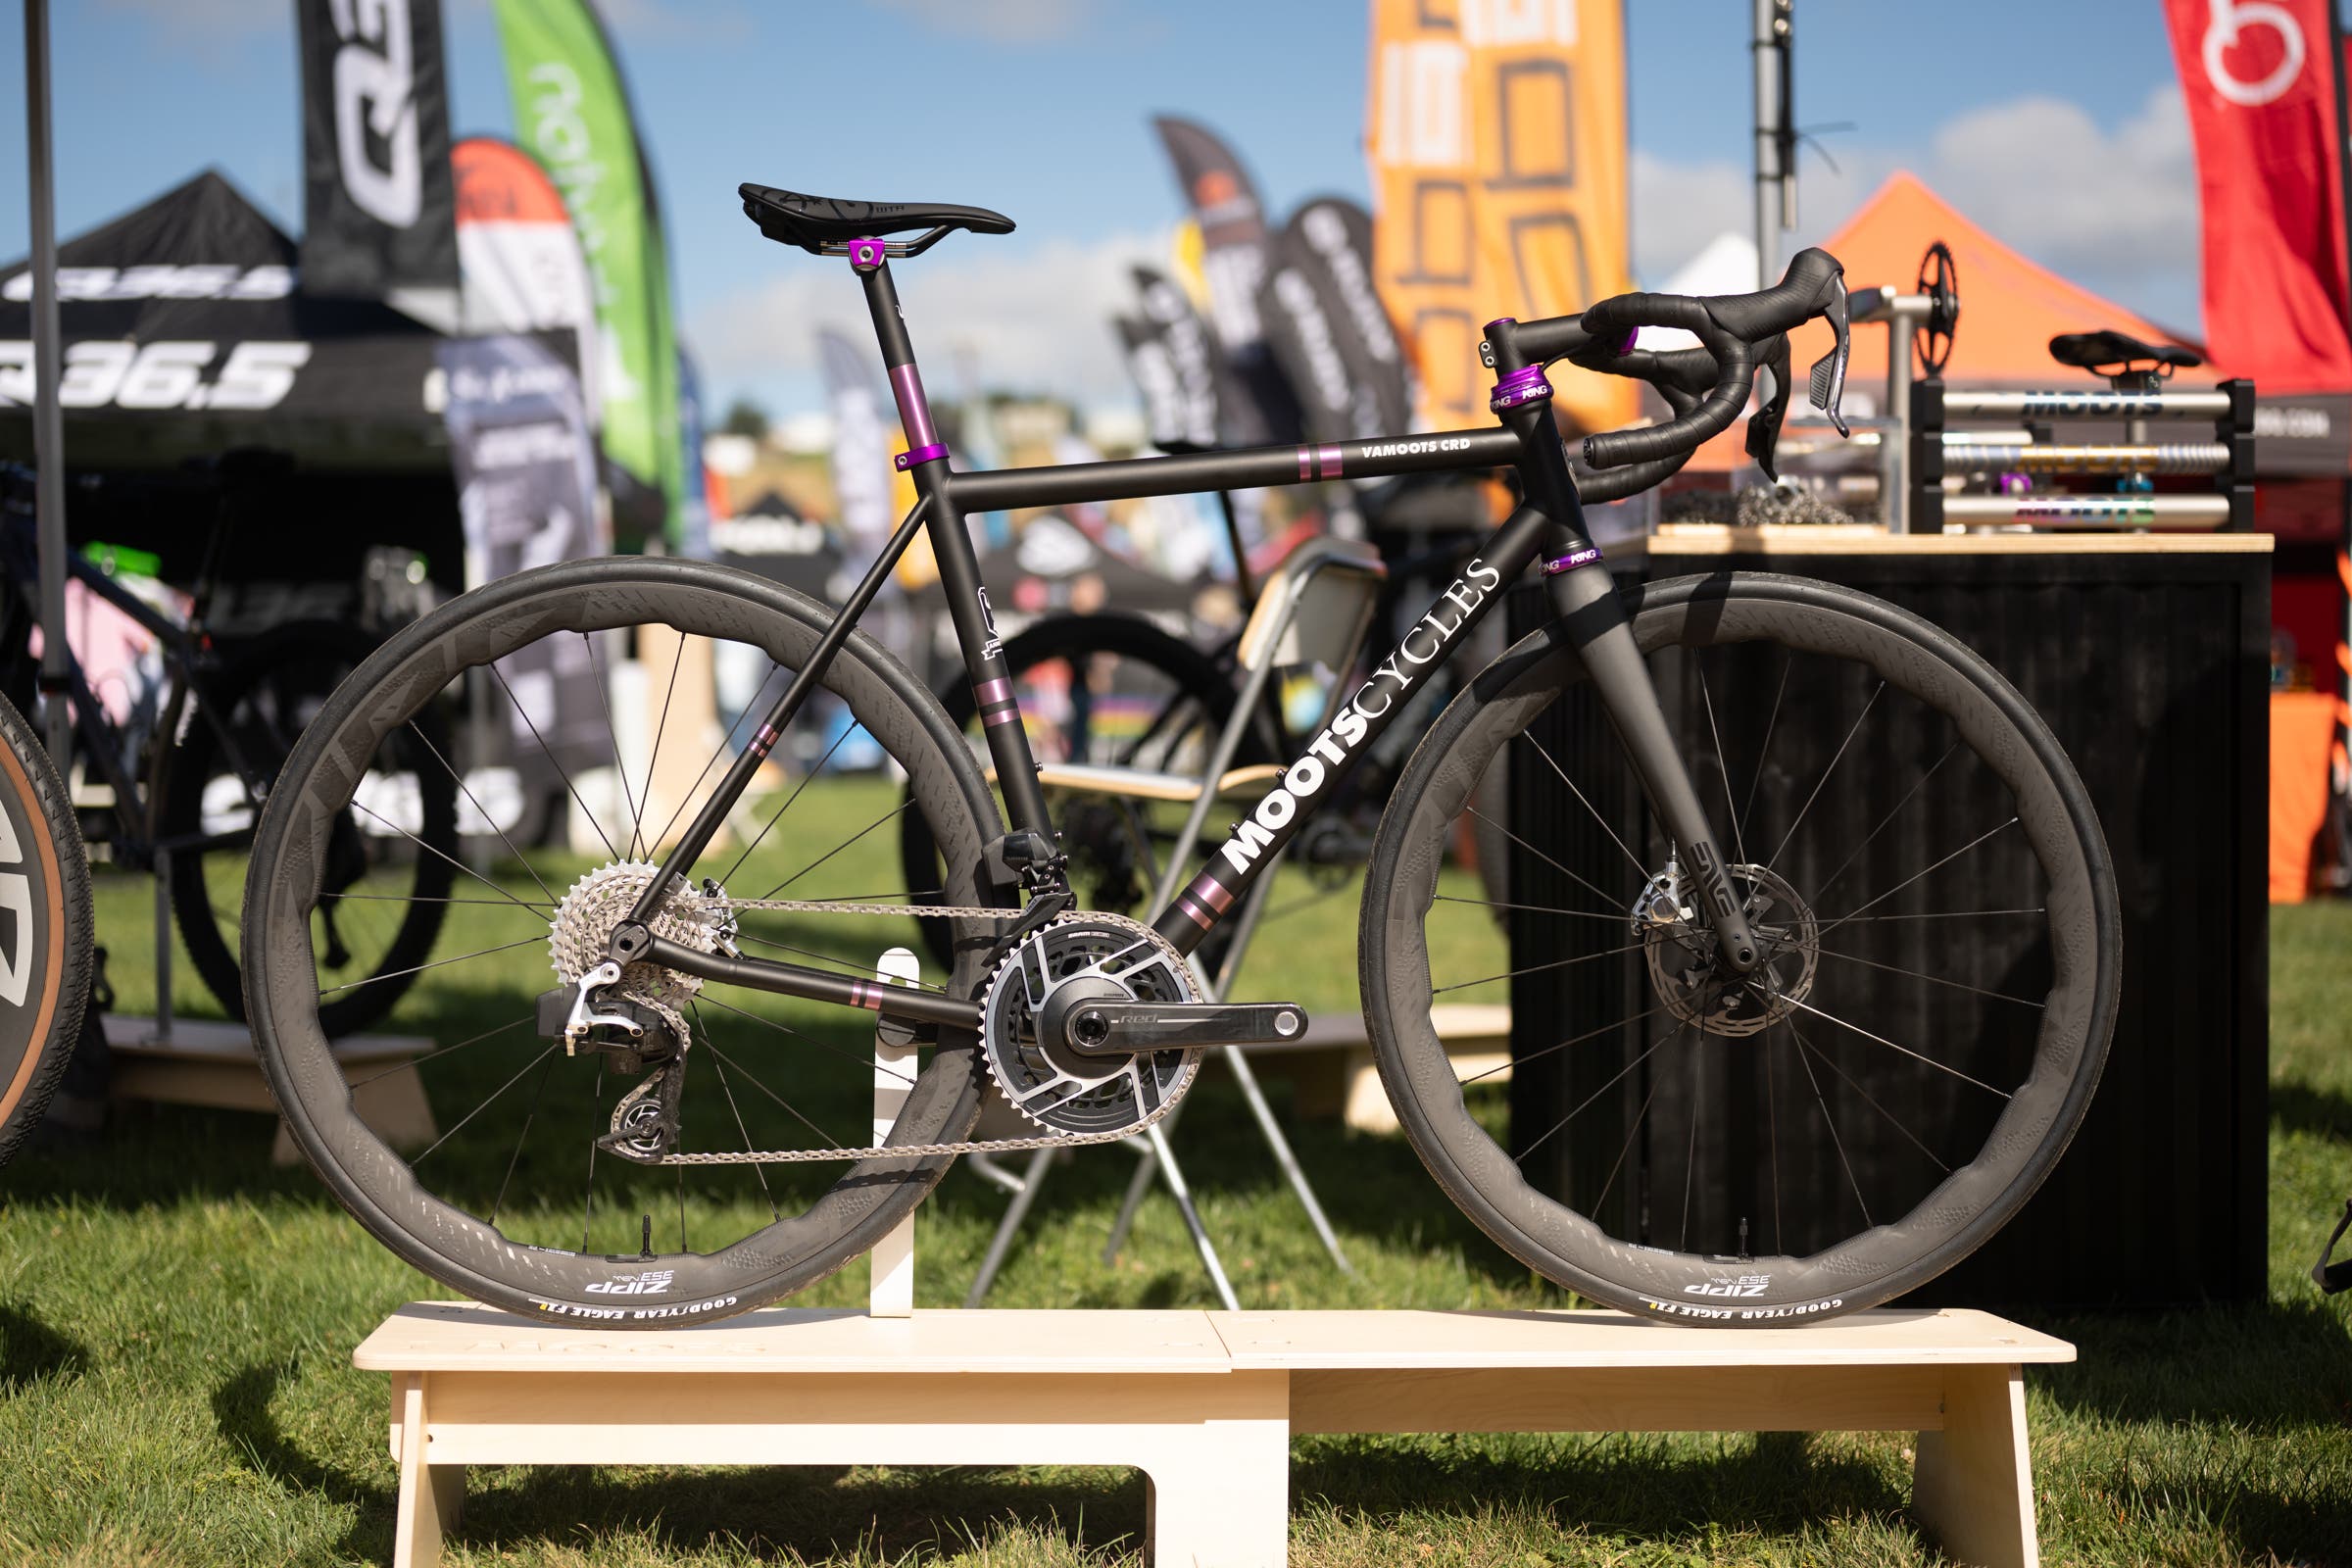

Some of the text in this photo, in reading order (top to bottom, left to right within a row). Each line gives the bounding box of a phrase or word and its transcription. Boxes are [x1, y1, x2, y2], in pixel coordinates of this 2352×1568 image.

[1522, 384, 1547, 400] KING
[2022, 391, 2163, 416] MOOTS
[1362, 438, 1471, 458] VAMOOTS CRD
[1570, 550, 1596, 564] KING
[585, 1280, 671, 1295] ZIPP
[1684, 1285, 1768, 1298] ZIPP
[570, 1306, 625, 1320] EAGLE
[634, 1297, 737, 1319] GOODYEAR
[1679, 1306, 1734, 1320] EAGLE
[1741, 1298, 1843, 1320] GOODYEAR
